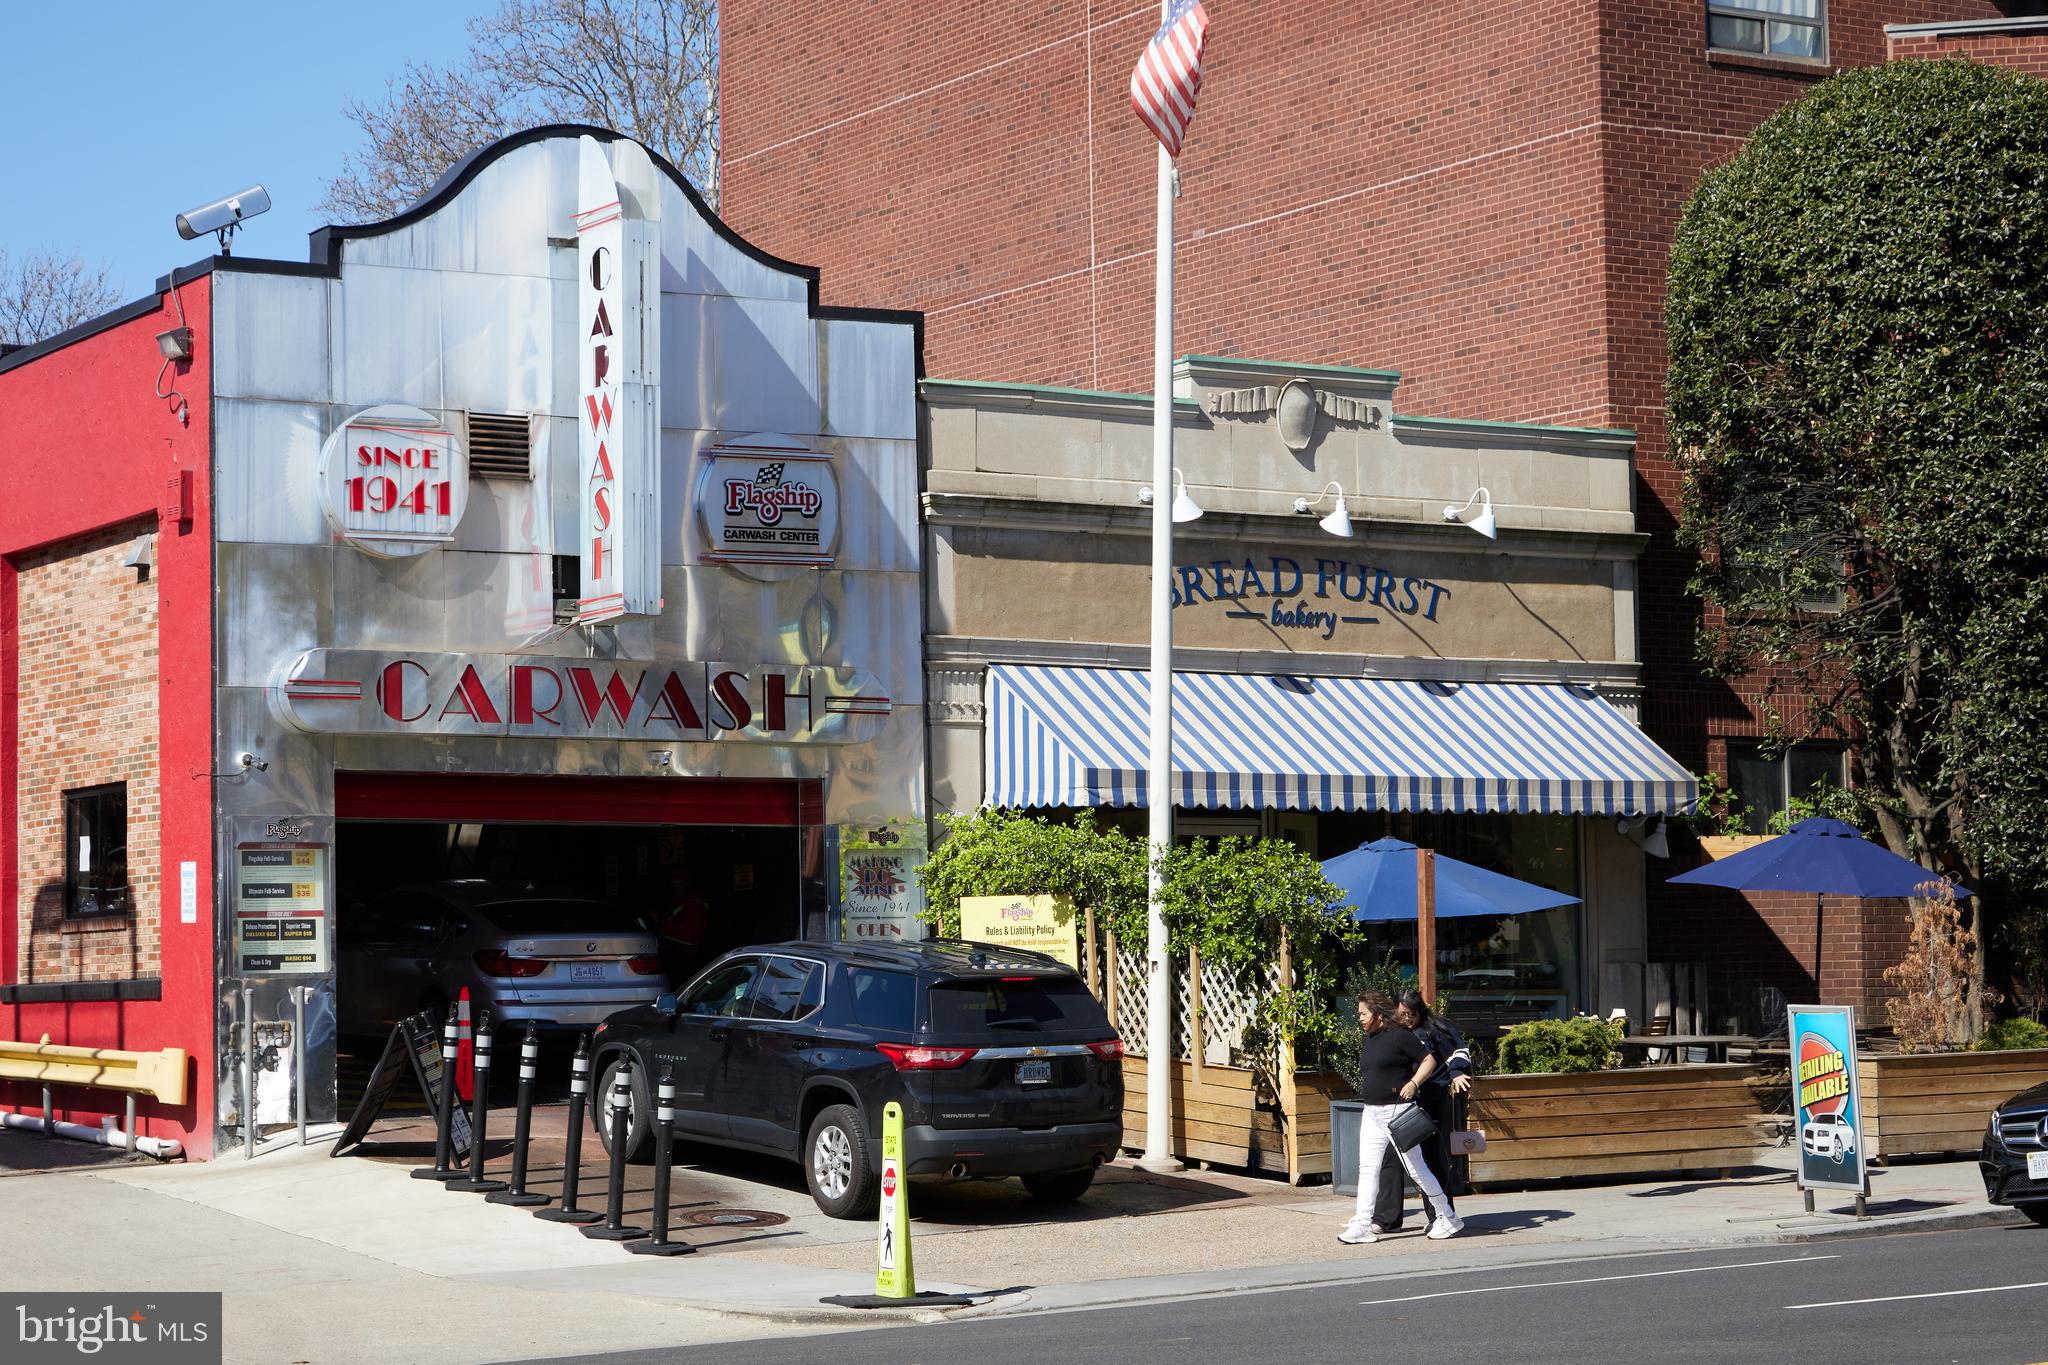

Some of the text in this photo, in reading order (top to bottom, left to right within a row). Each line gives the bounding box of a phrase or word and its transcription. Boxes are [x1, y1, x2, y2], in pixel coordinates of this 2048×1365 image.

[584, 246, 617, 582] CARWASH
[357, 445, 439, 470] SINCE
[344, 475, 451, 517] 1941
[725, 479, 822, 527] Flagship
[723, 529, 820, 543] CARWASH CENTER
[1313, 557, 1451, 624] FURST
[1271, 598, 1336, 641] bakery
[376, 659, 813, 733] CARWASH
[266, 823, 302, 840] Flagship
[847, 901, 910, 913] Since 1941
[1000, 907, 1034, 922] Flagship
[856, 923, 901, 937] OPEN
[985, 924, 1056, 937] Rules & Liability Policy
[883, 1176, 896, 1189] STOP
